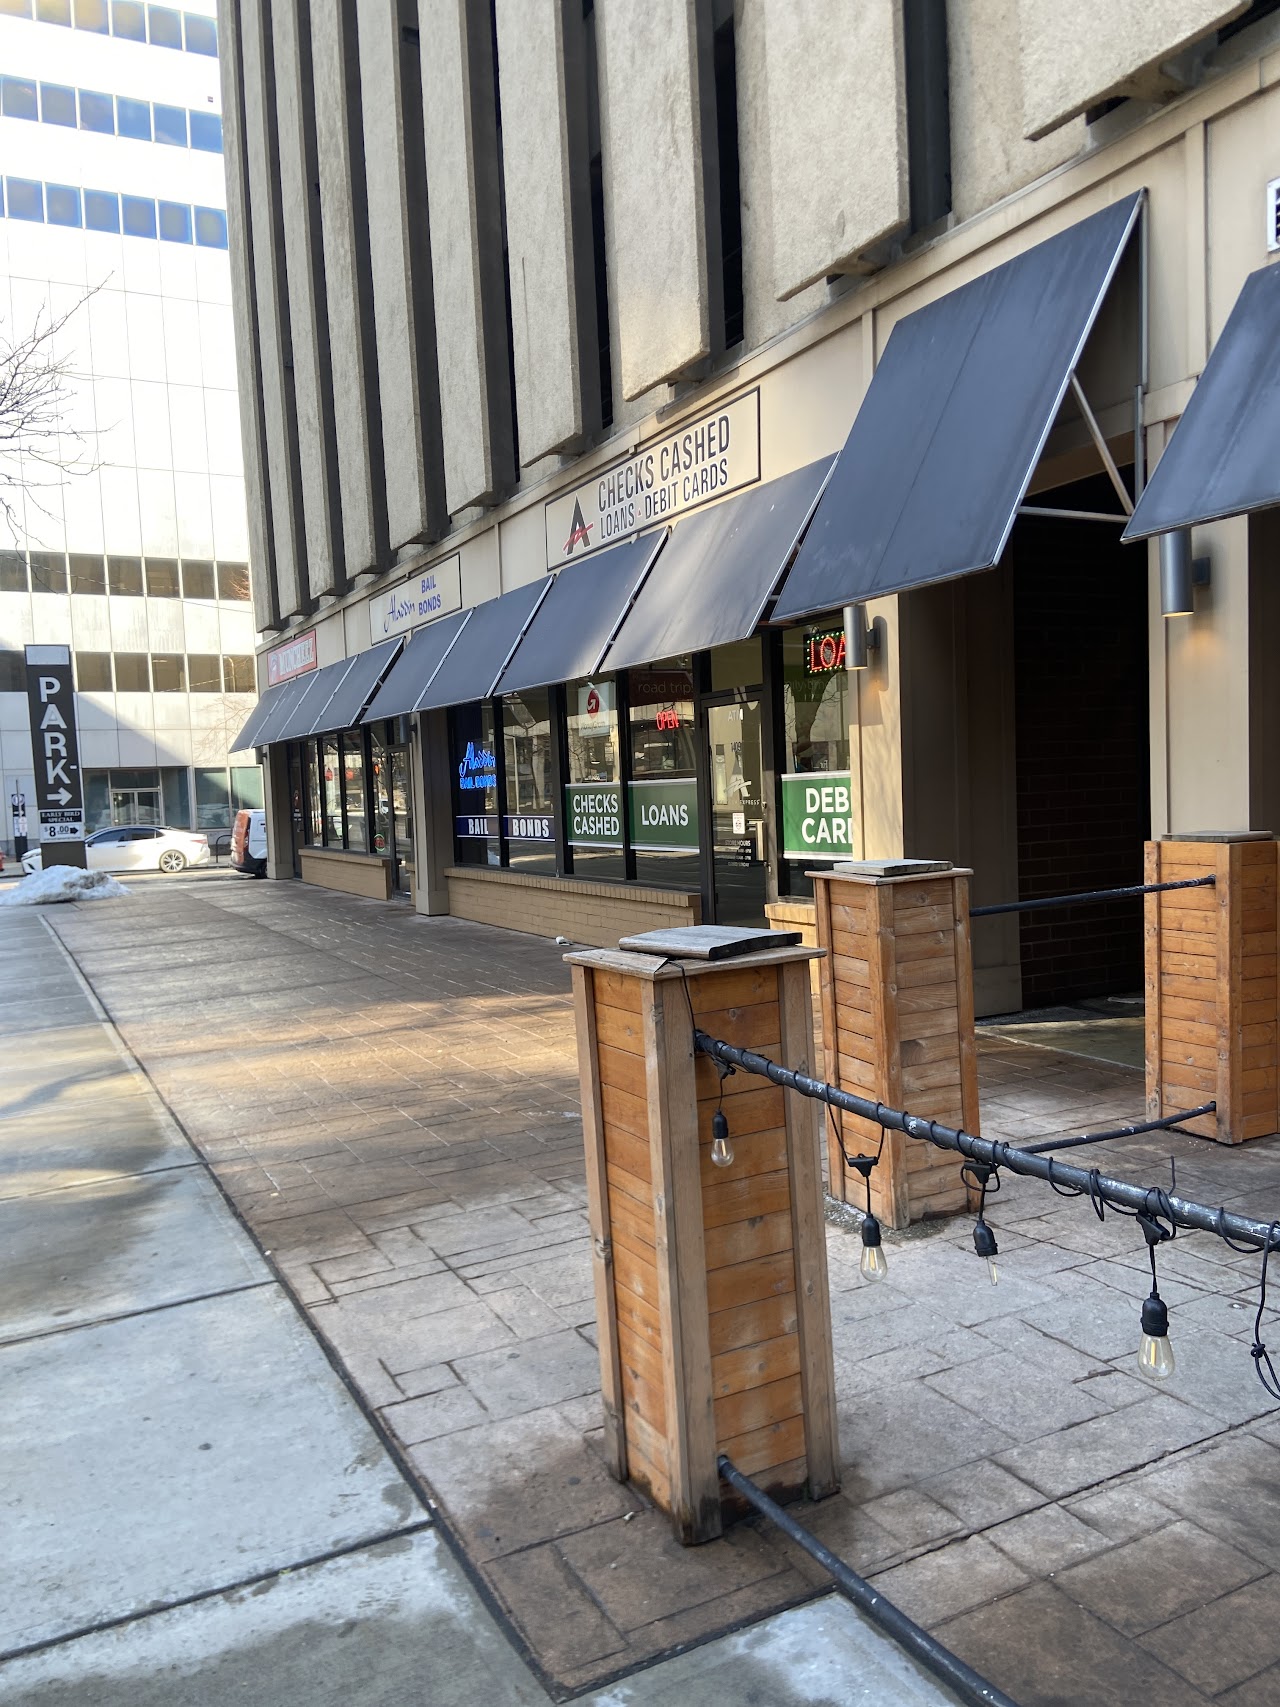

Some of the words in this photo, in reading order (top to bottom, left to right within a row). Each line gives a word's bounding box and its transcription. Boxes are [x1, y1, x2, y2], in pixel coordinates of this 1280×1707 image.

[598, 454, 655, 512] CHECKS
[660, 415, 731, 481] CASHED
[599, 502, 636, 540] LOANS
[644, 481, 680, 520] DEBIT
[683, 458, 729, 502] CARDS
[421, 575, 437, 593] BAIL
[418, 594, 441, 616] BONDS
[656, 710, 679, 731] OPEN
[573, 793, 618, 814] CHECKS
[805, 786, 853, 813] DEB
[573, 816, 619, 836] CASHED
[641, 804, 689, 827] LOANS
[468, 818, 489, 835] BAIL
[512, 819, 549, 838] BONDS
